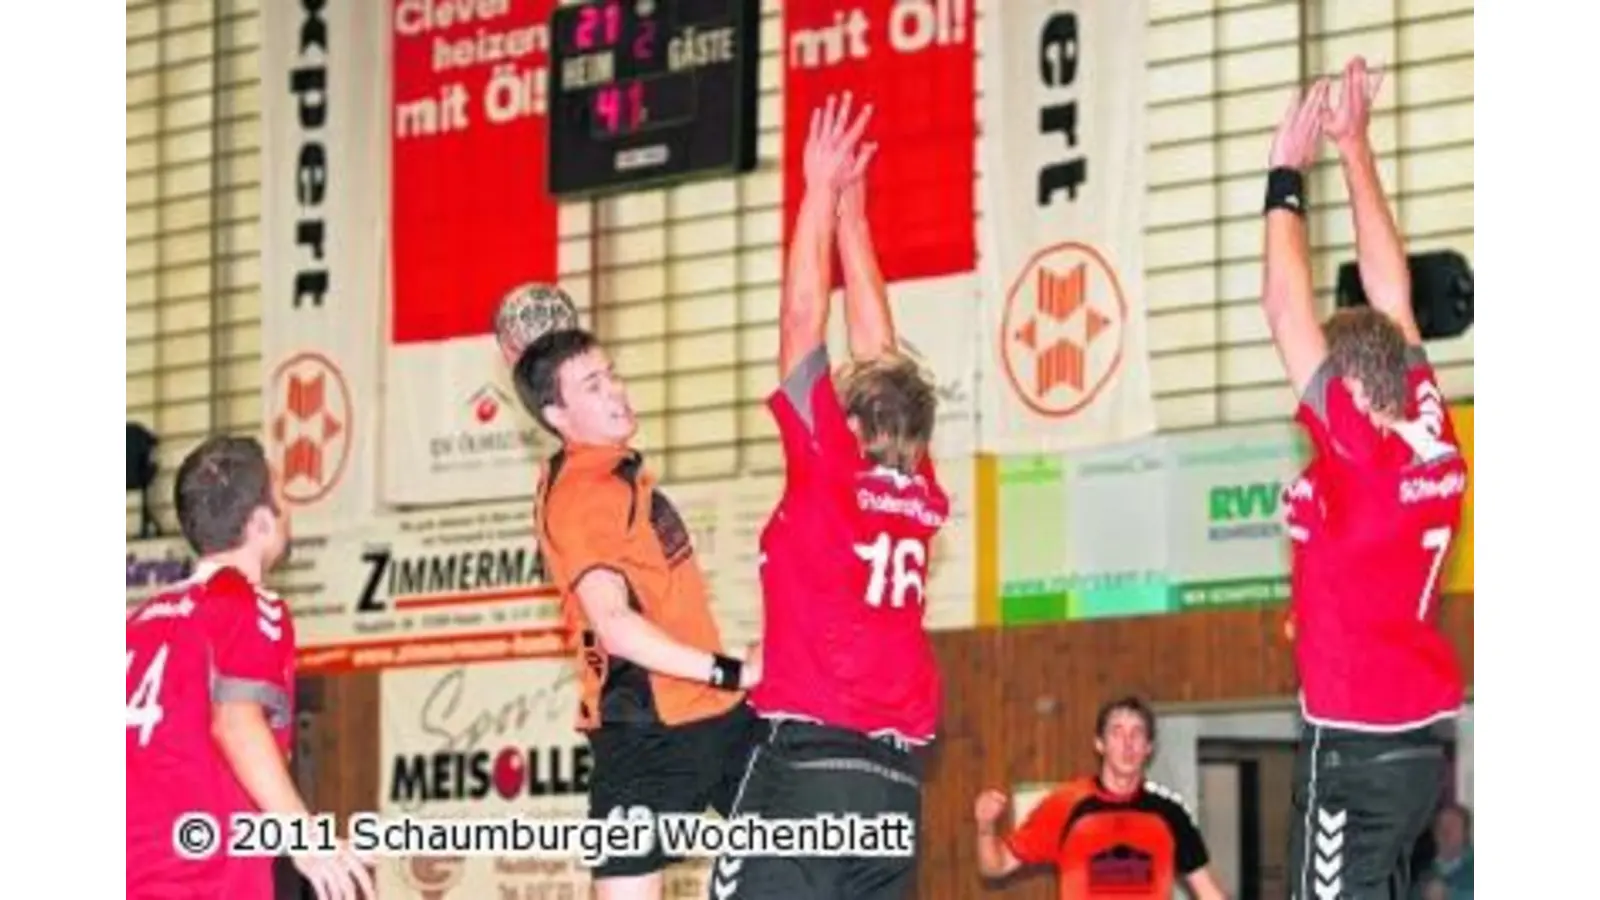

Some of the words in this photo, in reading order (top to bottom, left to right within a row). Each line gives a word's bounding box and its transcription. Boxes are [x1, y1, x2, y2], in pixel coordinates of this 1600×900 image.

[432, 24, 549, 74] heizen
[667, 26, 736, 72] GÄSTE
[789, 8, 870, 69] mit
[395, 82, 470, 140] mit
[484, 63, 549, 125] Öl!
[562, 52, 615, 91] HEIM
[852, 530, 926, 609] 16
[1418, 525, 1452, 622] 7
